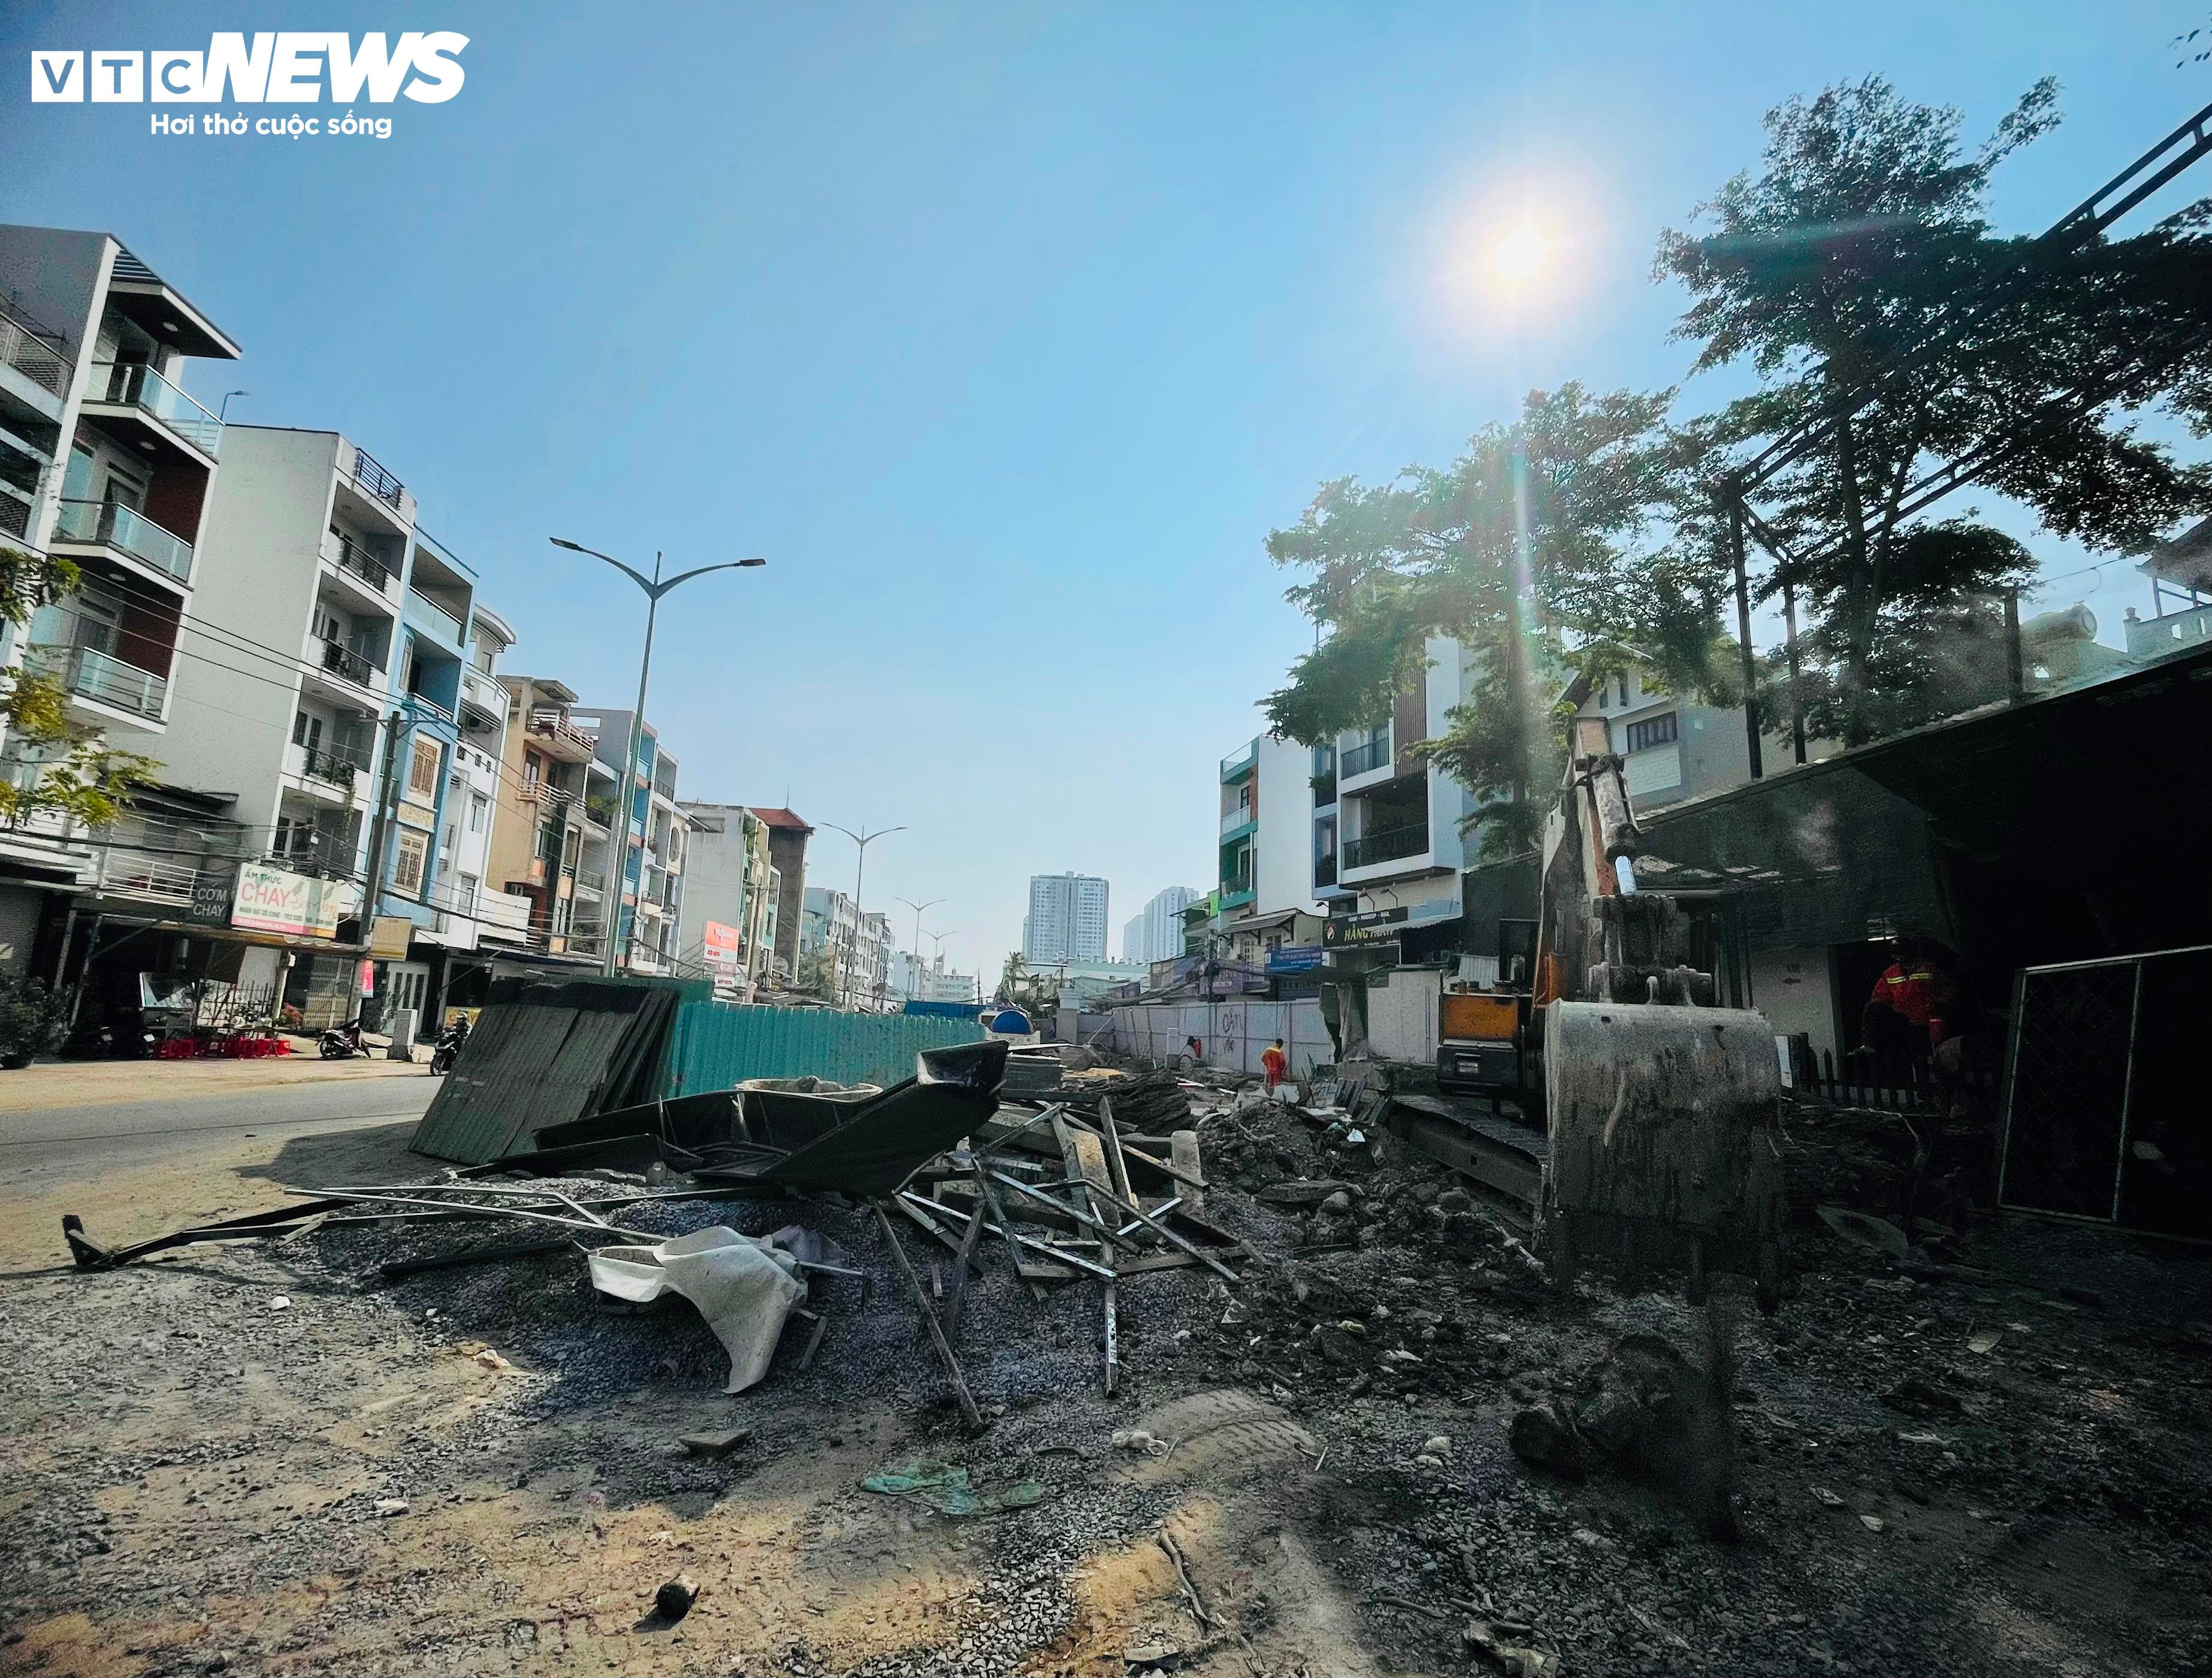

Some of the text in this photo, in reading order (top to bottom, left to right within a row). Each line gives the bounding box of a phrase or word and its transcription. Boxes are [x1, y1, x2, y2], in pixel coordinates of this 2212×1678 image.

[197, 888, 228, 902] CƠM
[241, 882, 291, 908] CHAY
[193, 903, 226, 917] CHAY
